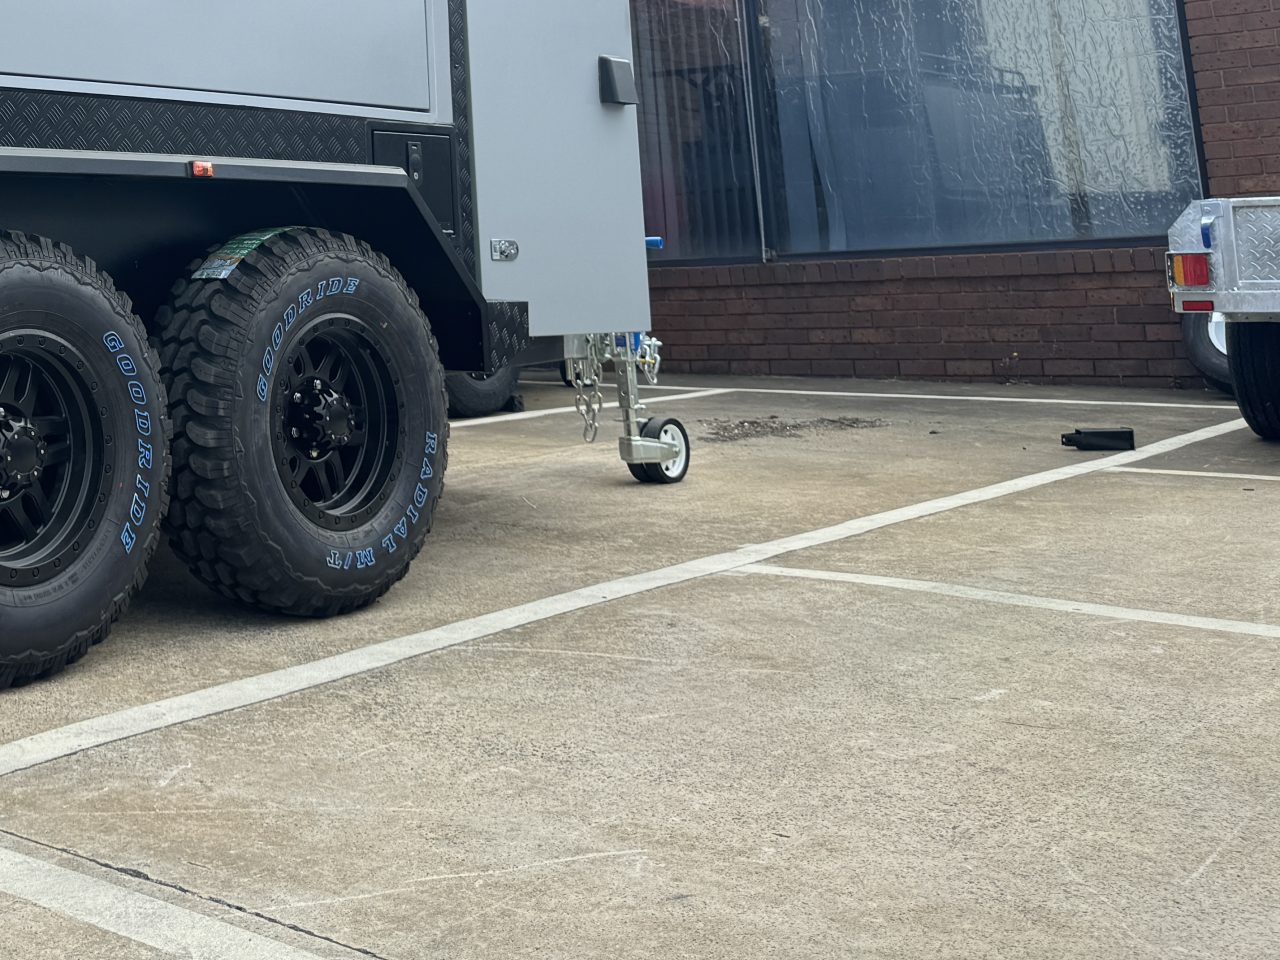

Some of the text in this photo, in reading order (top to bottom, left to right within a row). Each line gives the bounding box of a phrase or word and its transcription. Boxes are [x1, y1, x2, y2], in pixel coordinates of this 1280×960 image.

[257, 277, 359, 401] GOODRIDE
[103, 331, 153, 554] GOODRIDE
[382, 431, 438, 553] RADIAL
[326, 547, 376, 569] M/T
